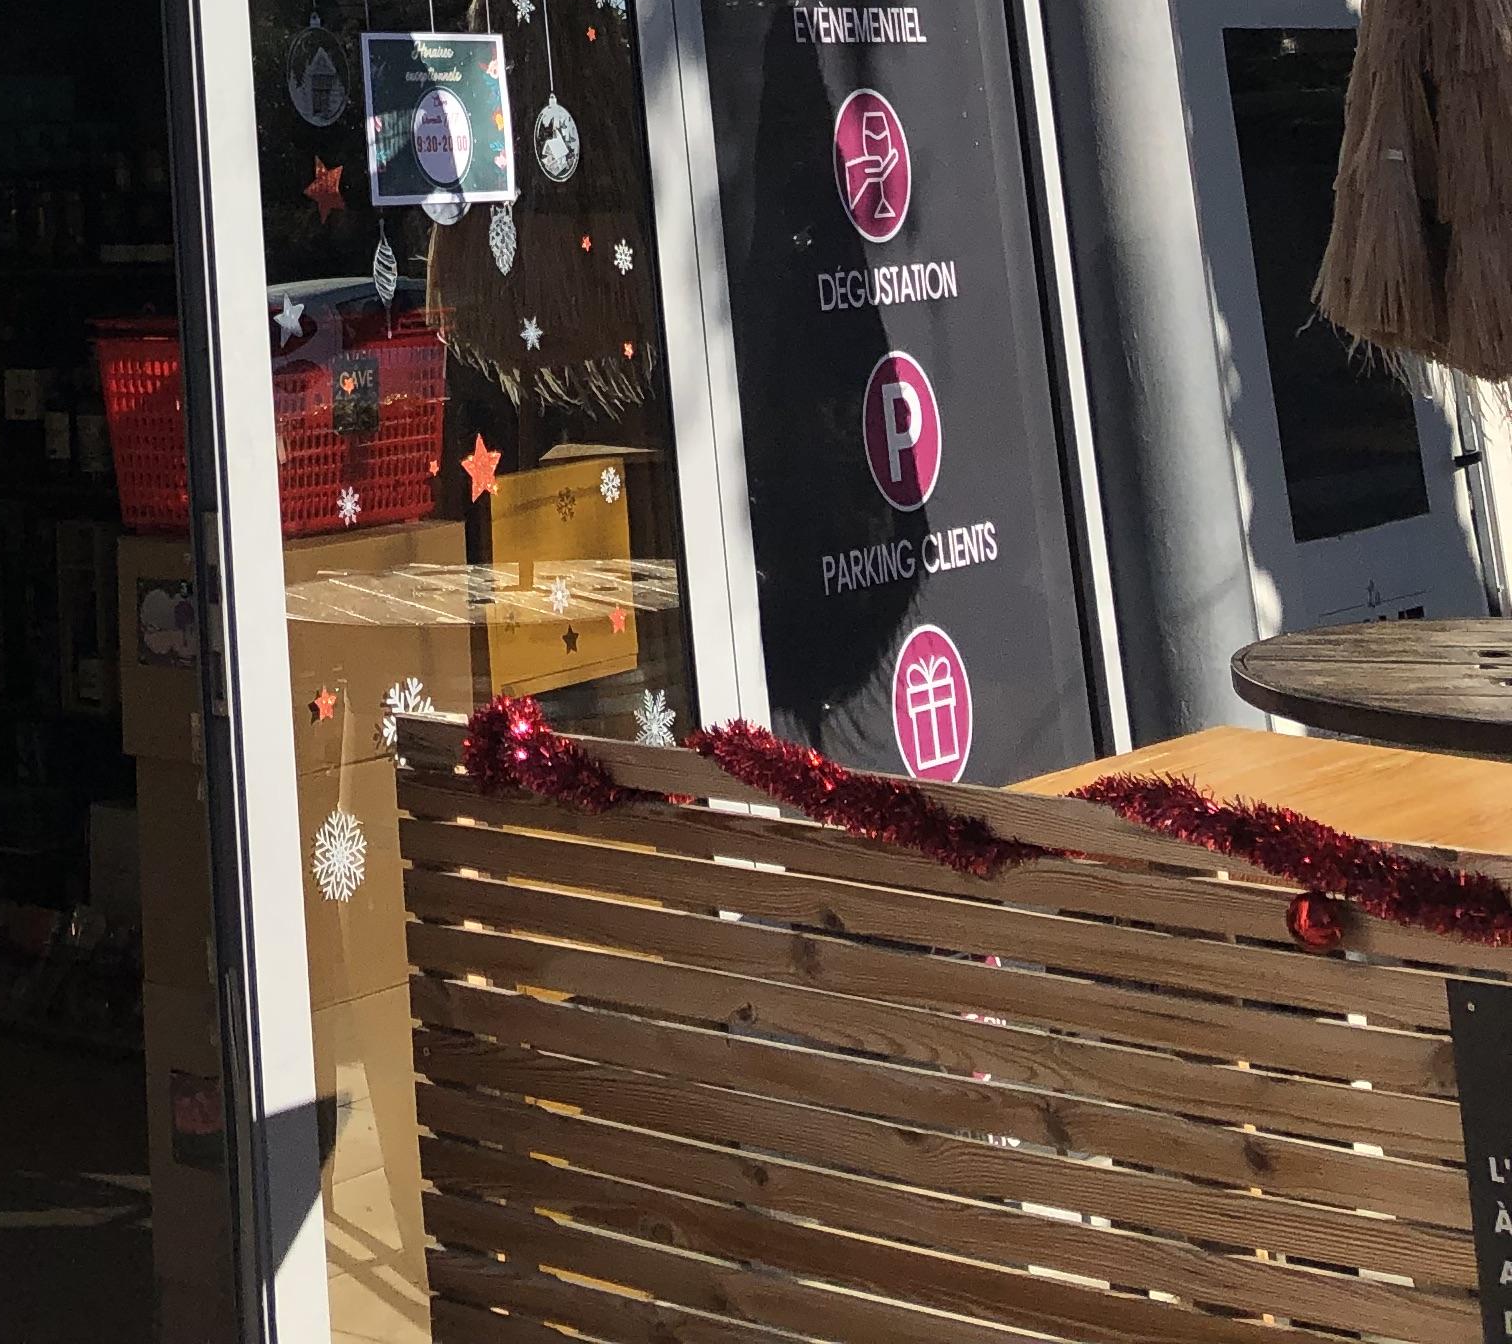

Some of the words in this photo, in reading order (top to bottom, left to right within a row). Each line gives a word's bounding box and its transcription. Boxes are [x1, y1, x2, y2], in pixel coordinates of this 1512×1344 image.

[817, 260, 959, 312] DÉGUSTATION
[881, 380, 923, 483] P
[822, 538, 916, 596] PARKING
[920, 520, 999, 574] CLIENTS
